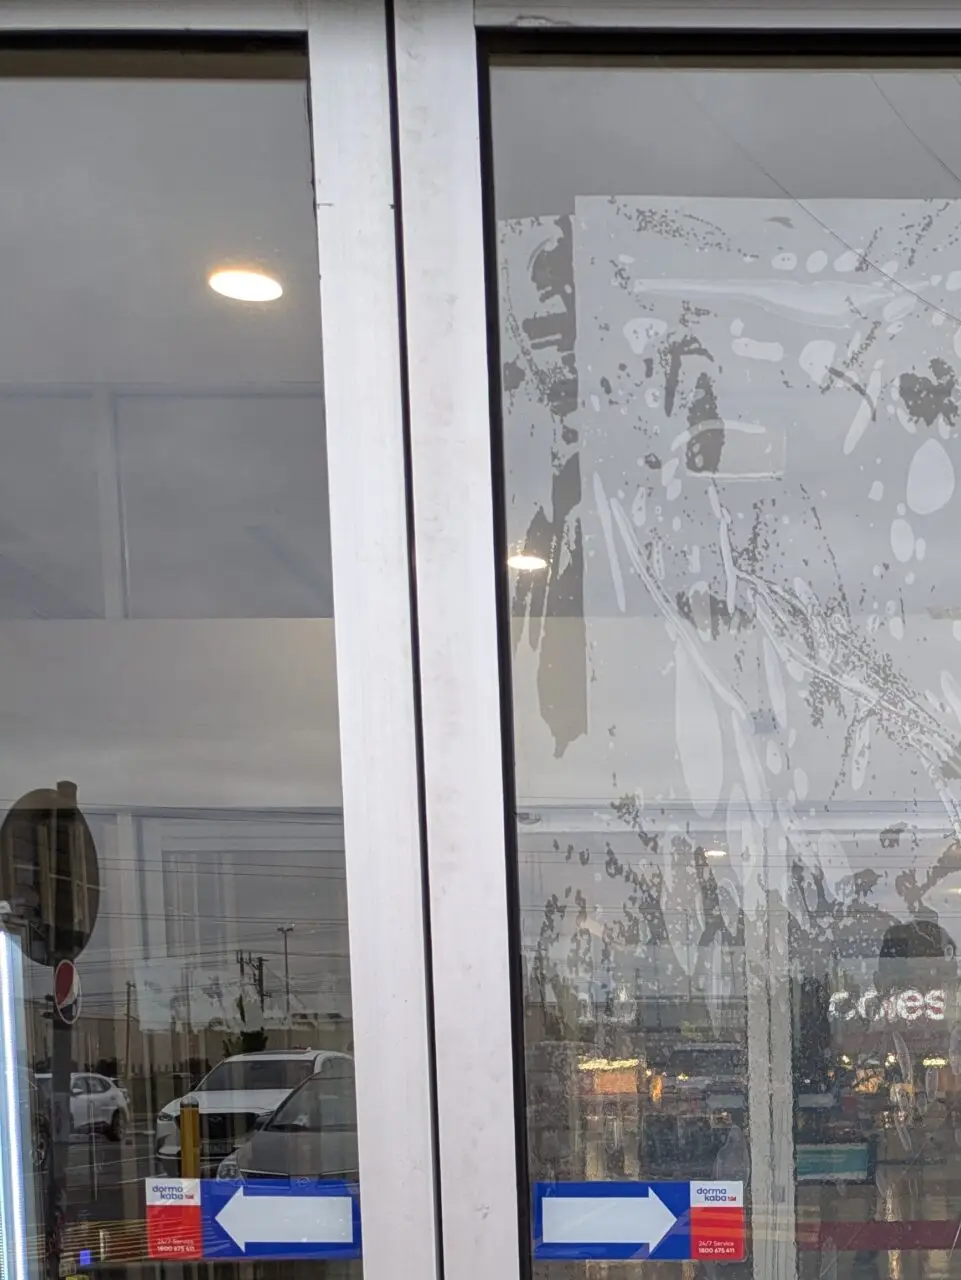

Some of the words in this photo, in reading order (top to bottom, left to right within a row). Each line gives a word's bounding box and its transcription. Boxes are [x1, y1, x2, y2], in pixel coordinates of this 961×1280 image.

[152, 1185, 183, 1193] dorma
[696, 1187, 727, 1195] dorma
[160, 1192, 184, 1200] kaba
[704, 1193, 727, 1202] kaba
